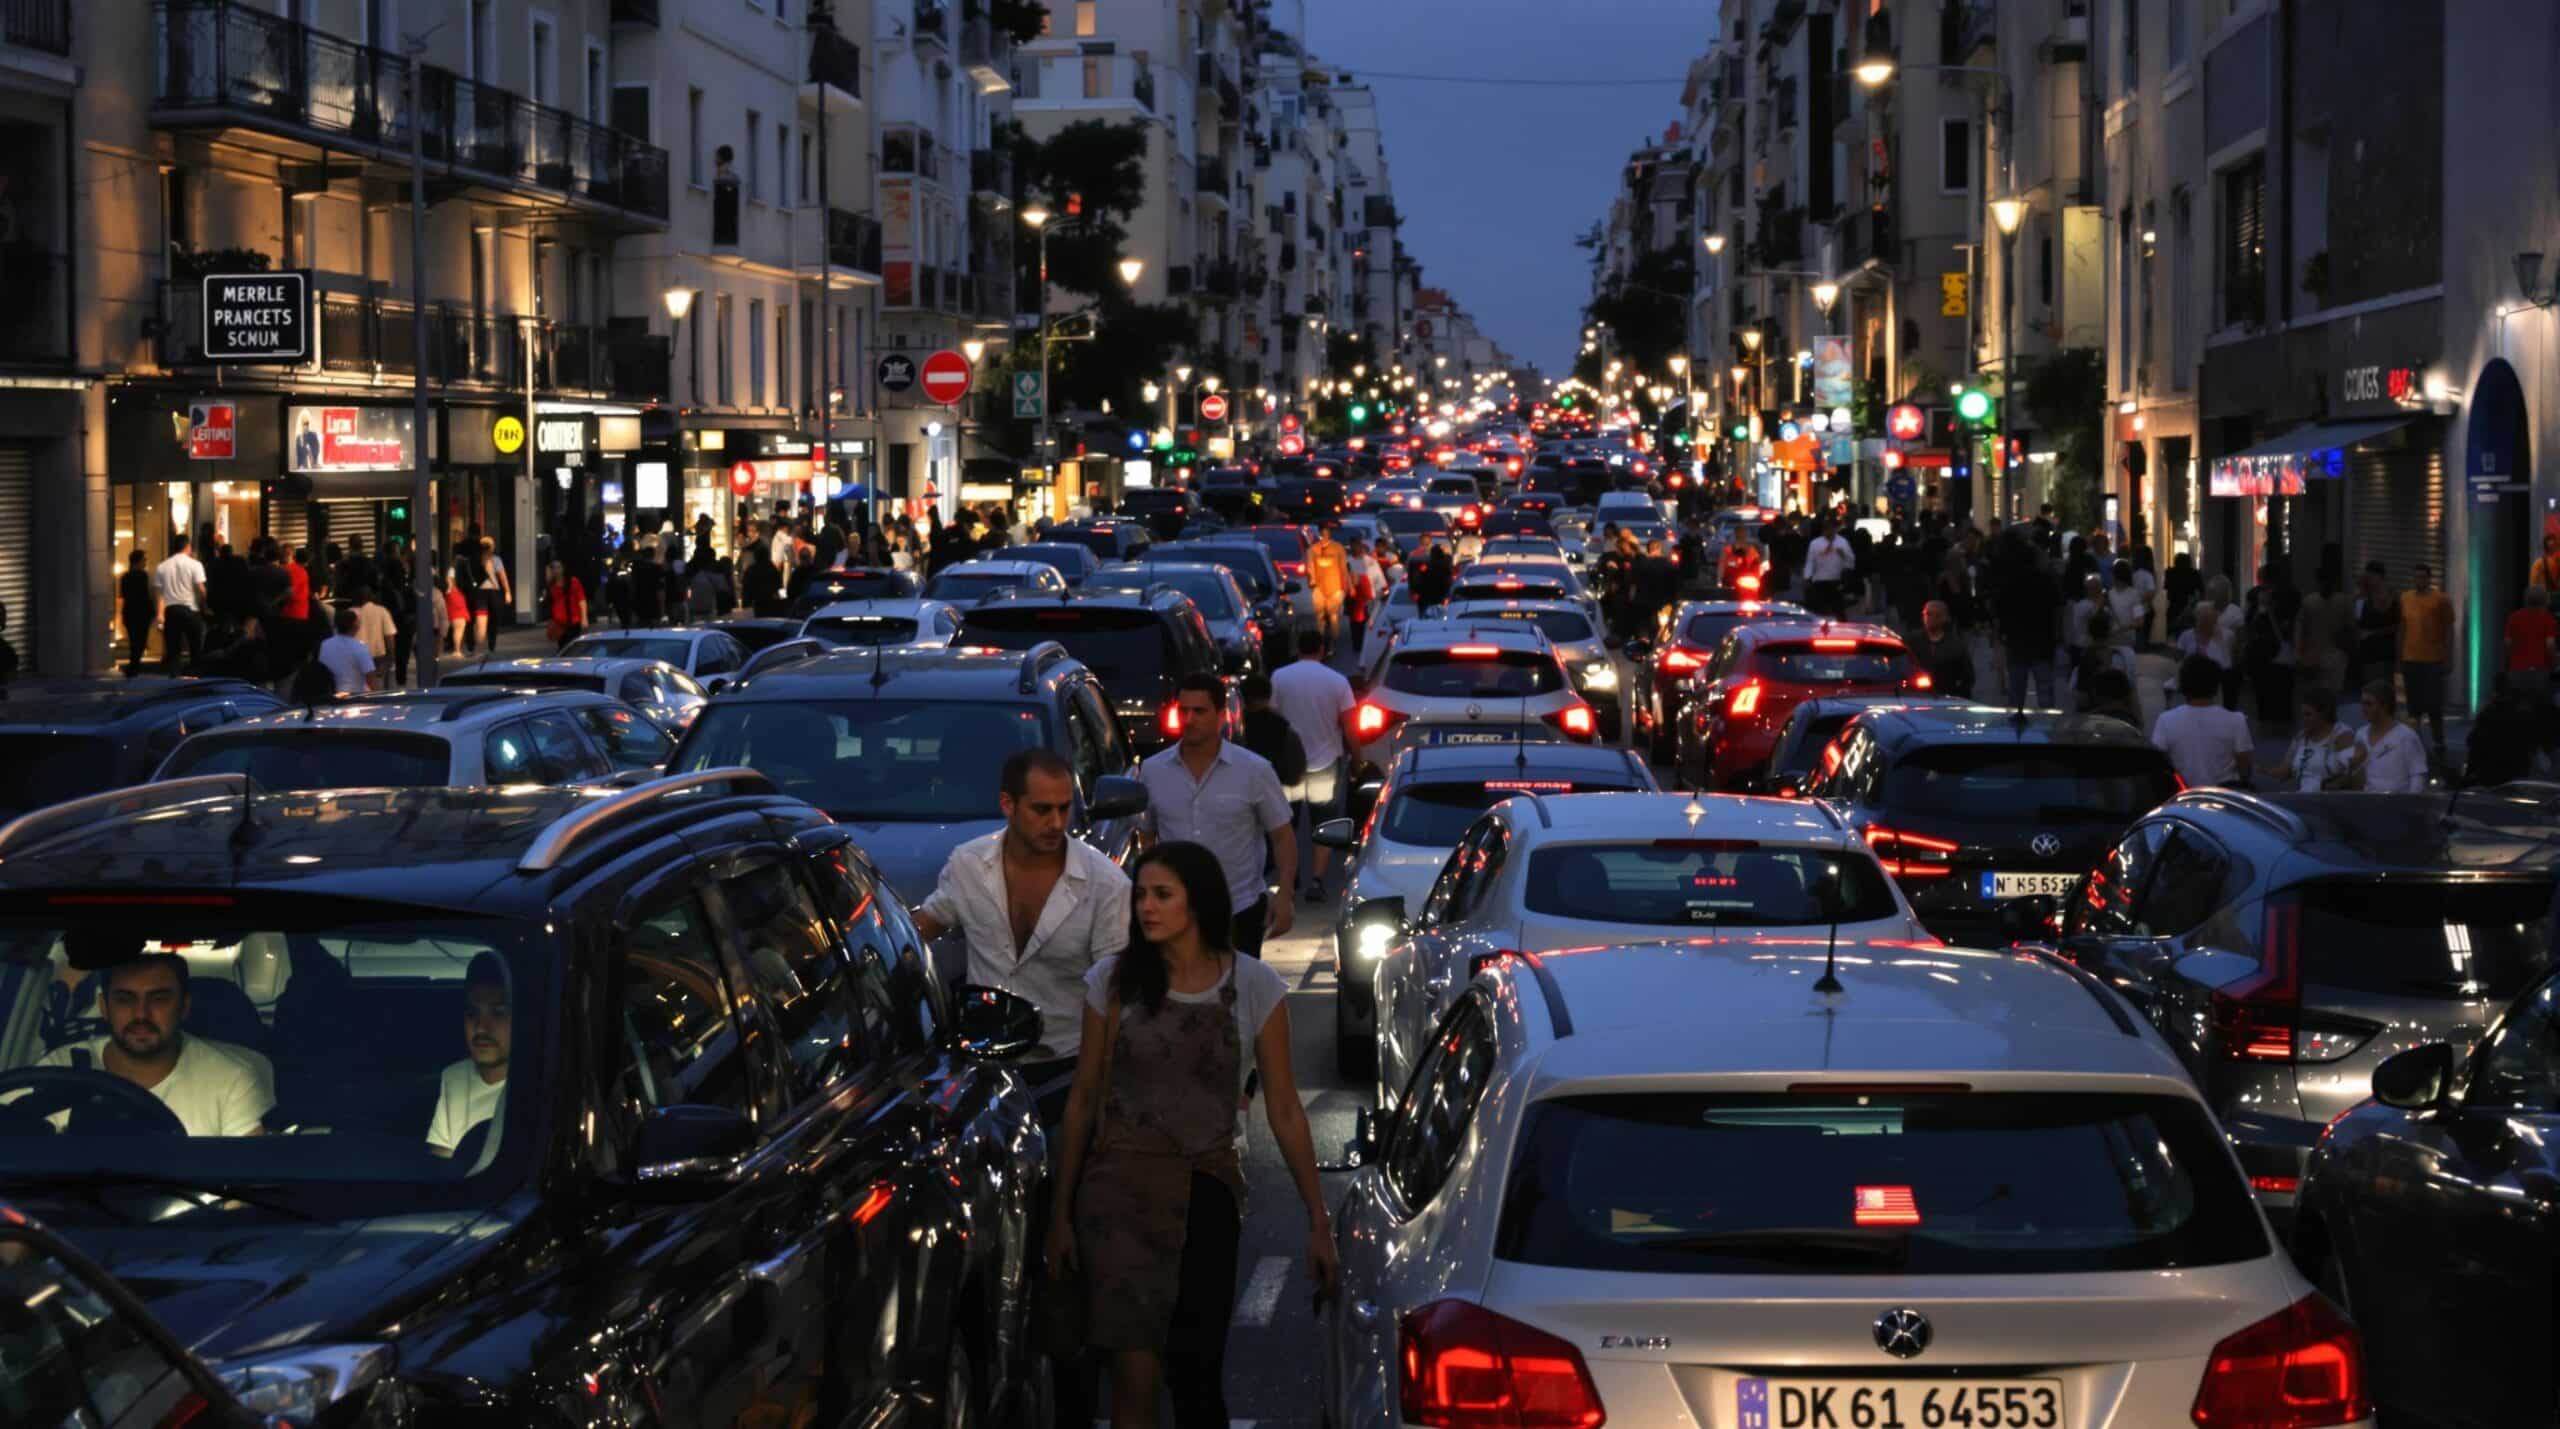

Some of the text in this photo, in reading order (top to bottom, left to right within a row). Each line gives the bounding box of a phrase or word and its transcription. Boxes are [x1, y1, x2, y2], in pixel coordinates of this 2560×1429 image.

[223, 286, 285, 302] MERRLE
[1779, 1386, 2057, 1428] DK 61 64553
